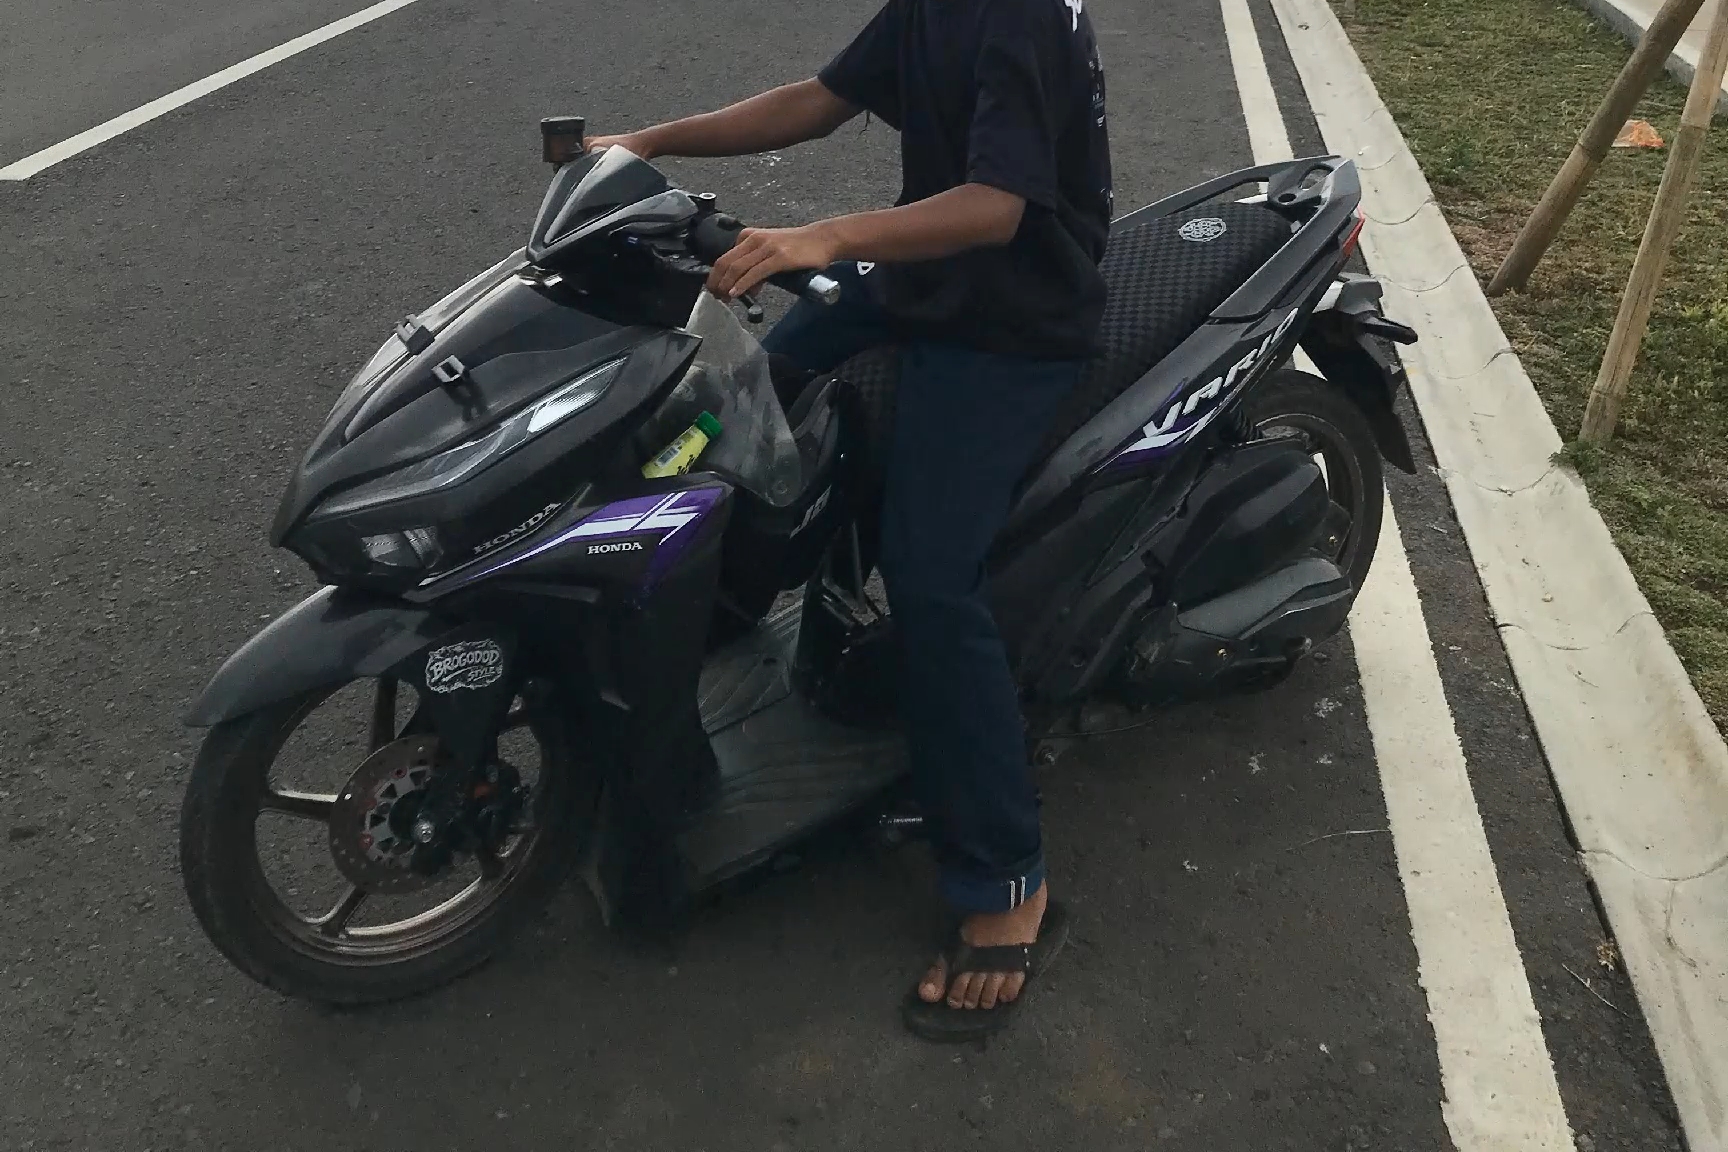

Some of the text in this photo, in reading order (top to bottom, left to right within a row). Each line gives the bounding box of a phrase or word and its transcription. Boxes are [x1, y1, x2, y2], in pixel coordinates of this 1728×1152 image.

[472, 502, 562, 554] HONDA
[587, 541, 643, 555] HONDA
[467, 666, 496, 682] STYLE
